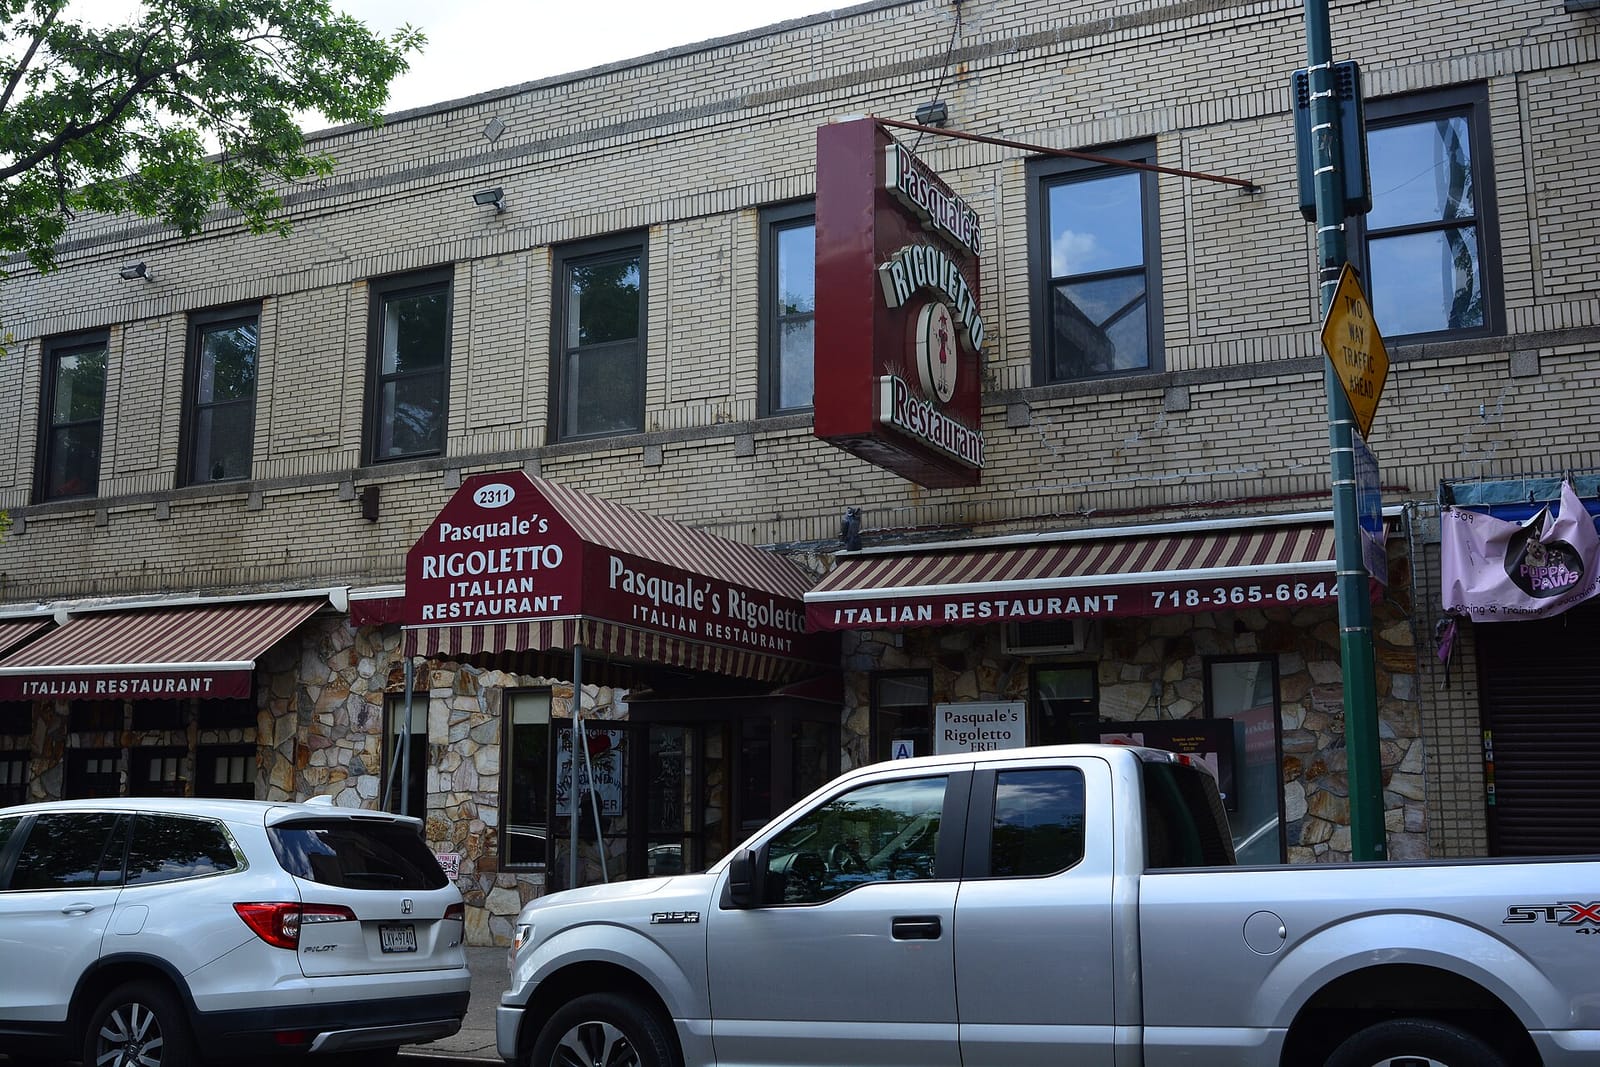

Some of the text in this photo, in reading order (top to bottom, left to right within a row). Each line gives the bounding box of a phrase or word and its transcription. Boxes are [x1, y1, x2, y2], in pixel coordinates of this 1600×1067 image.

[897, 143, 983, 257] Pasquale's
[890, 243, 985, 352] RIGOLETTO
[1345, 296, 1362, 319] TWO
[1348, 321, 1364, 345] WAY
[1342, 345, 1375, 374] TRAFFIC
[1349, 376, 1374, 400] AHEAD
[893, 373, 985, 469] Restaurant
[479, 488, 510, 505] 2311
[439, 514, 548, 543] Pasquale's
[422, 544, 563, 580] RIGOLETTO
[450, 577, 534, 598] ITALIAN
[1531, 571, 1579, 591] PAWS
[609, 555, 806, 635] Pasquale's Rigoletto
[421, 595, 563, 620] RESTAURANT
[834, 603, 933, 624] ITALIAN
[944, 594, 1119, 621] RESTAURANT
[1502, 605, 1542, 616] Training
[632, 604, 793, 654] ITALIAN RESTAURANT
[23, 677, 213, 695] ITALIAN RESTAURANT
[944, 708, 1018, 727] Pasquale's
[944, 727, 1011, 745] Rigoletto
[896, 743, 909, 760] A
[1503, 901, 1600, 927] STX
[304, 944, 338, 953] PILOT
